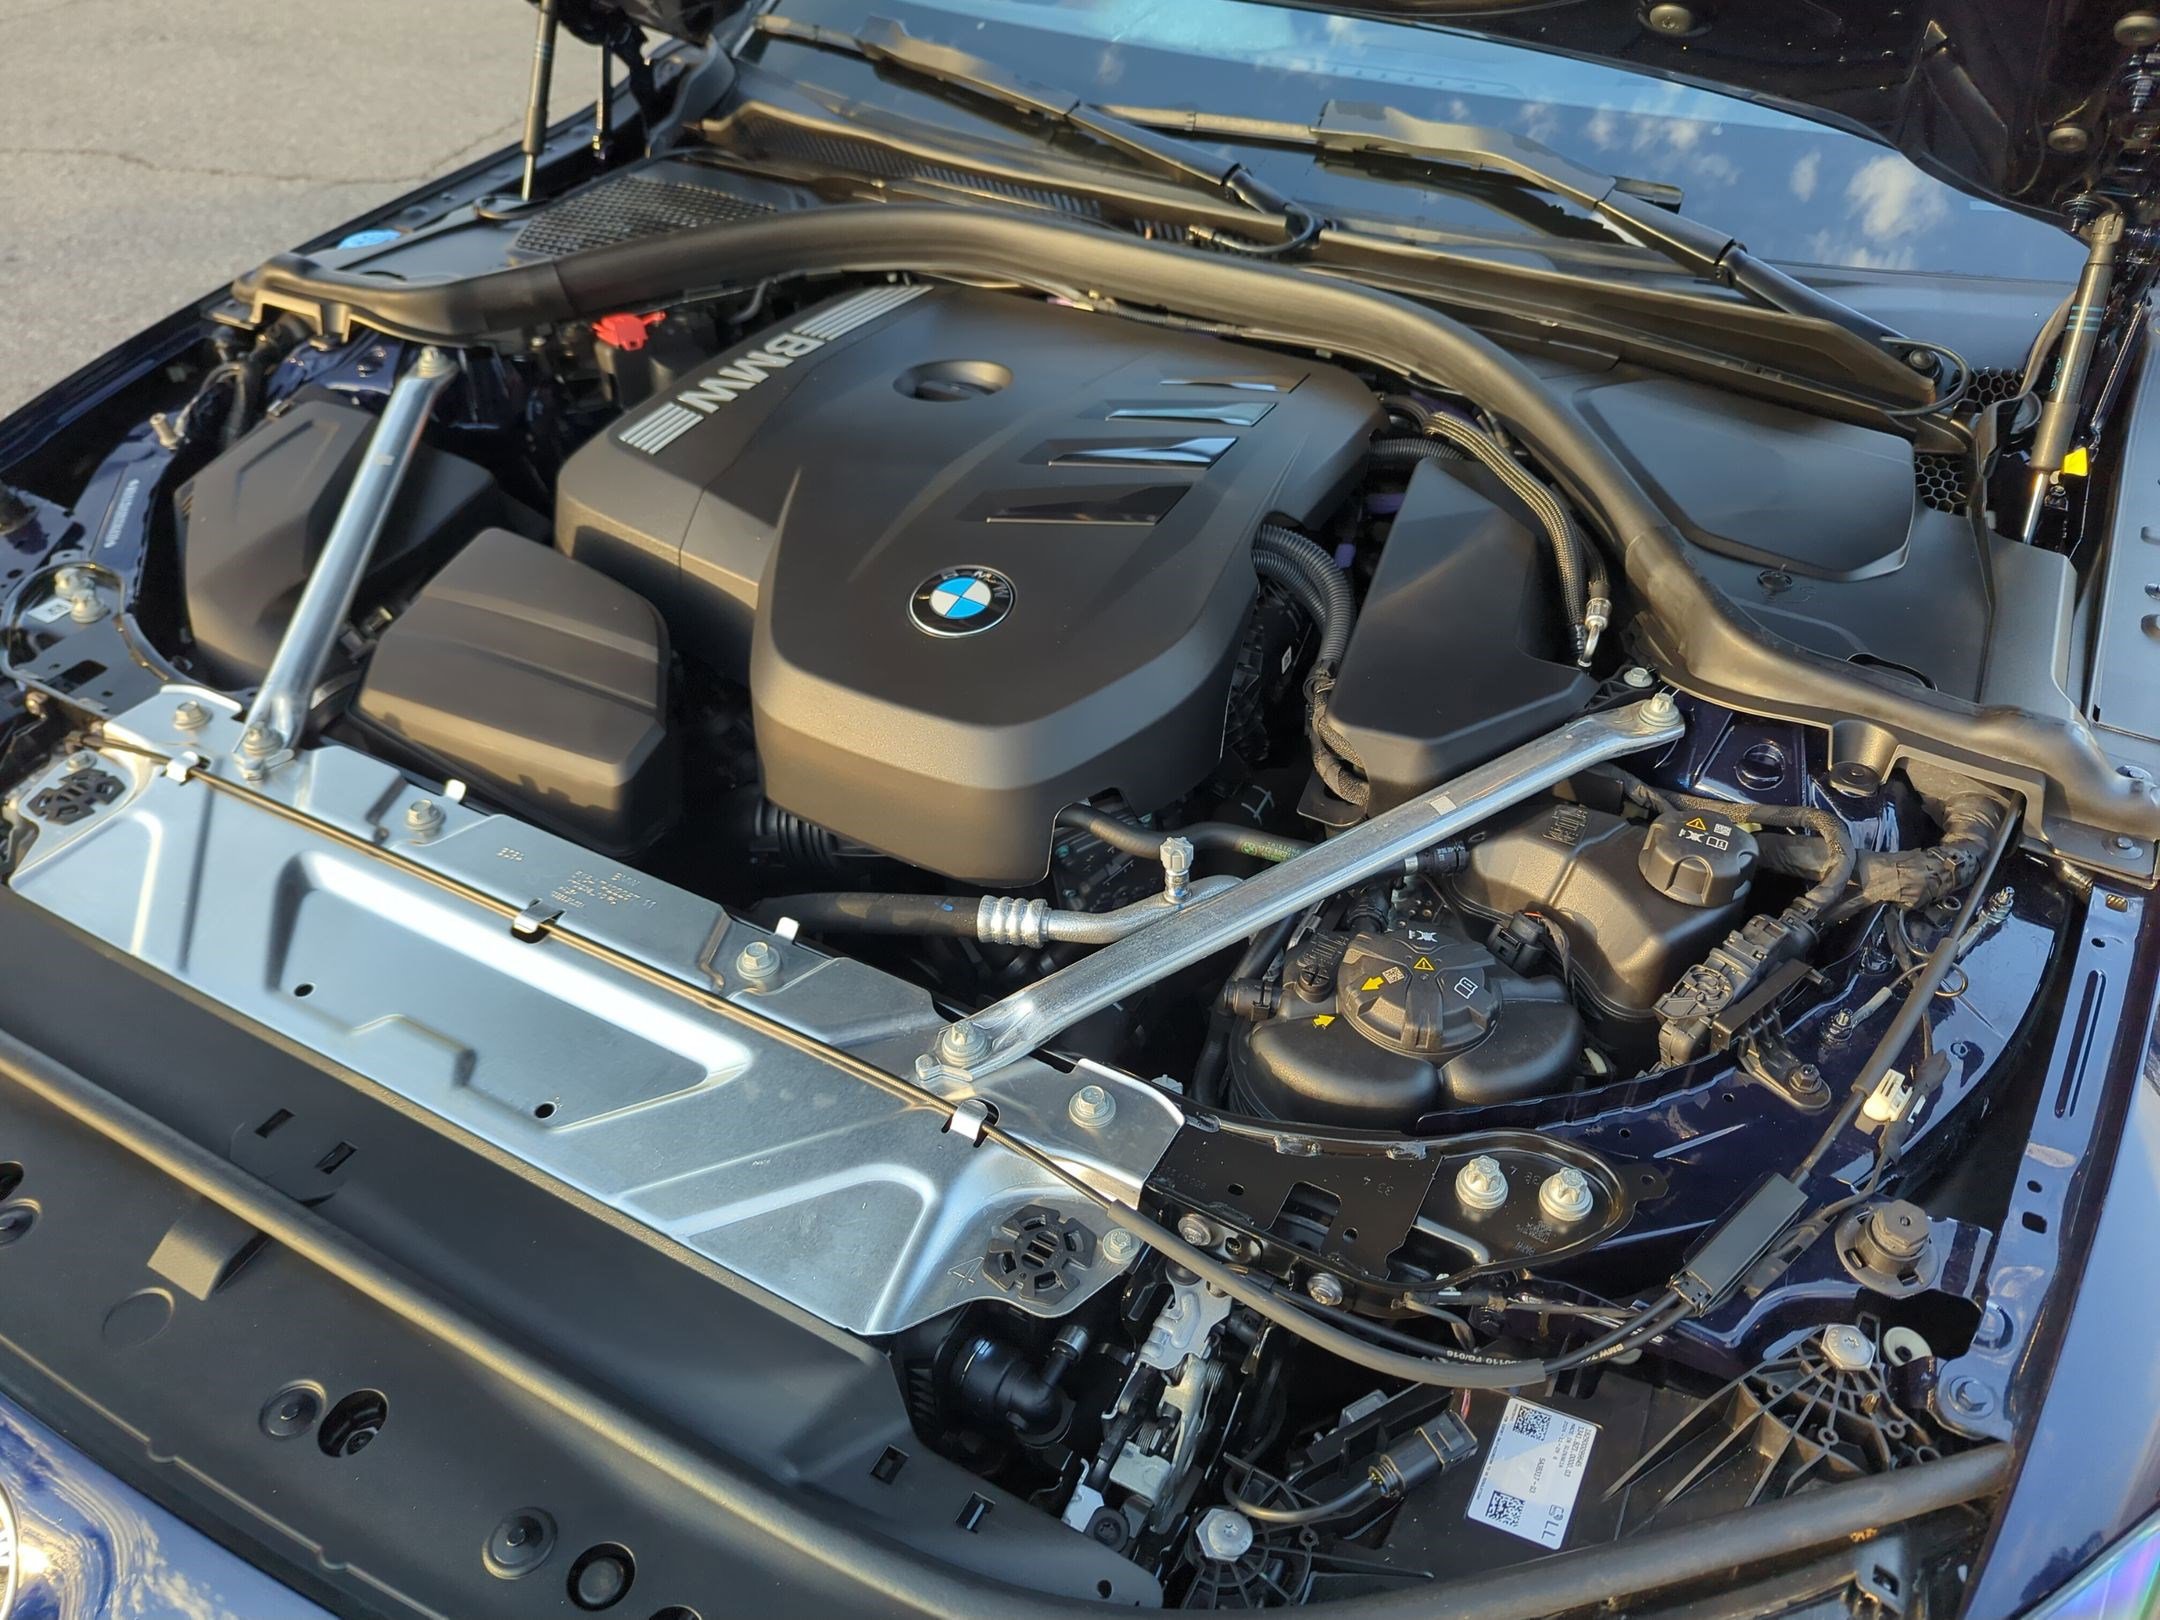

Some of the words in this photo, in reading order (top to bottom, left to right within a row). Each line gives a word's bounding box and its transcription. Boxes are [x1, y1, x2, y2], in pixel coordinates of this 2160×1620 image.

[677, 332, 826, 414] BMW
[1599, 1344, 1625, 1359] BMW
[1540, 1519, 1559, 1542] LL
